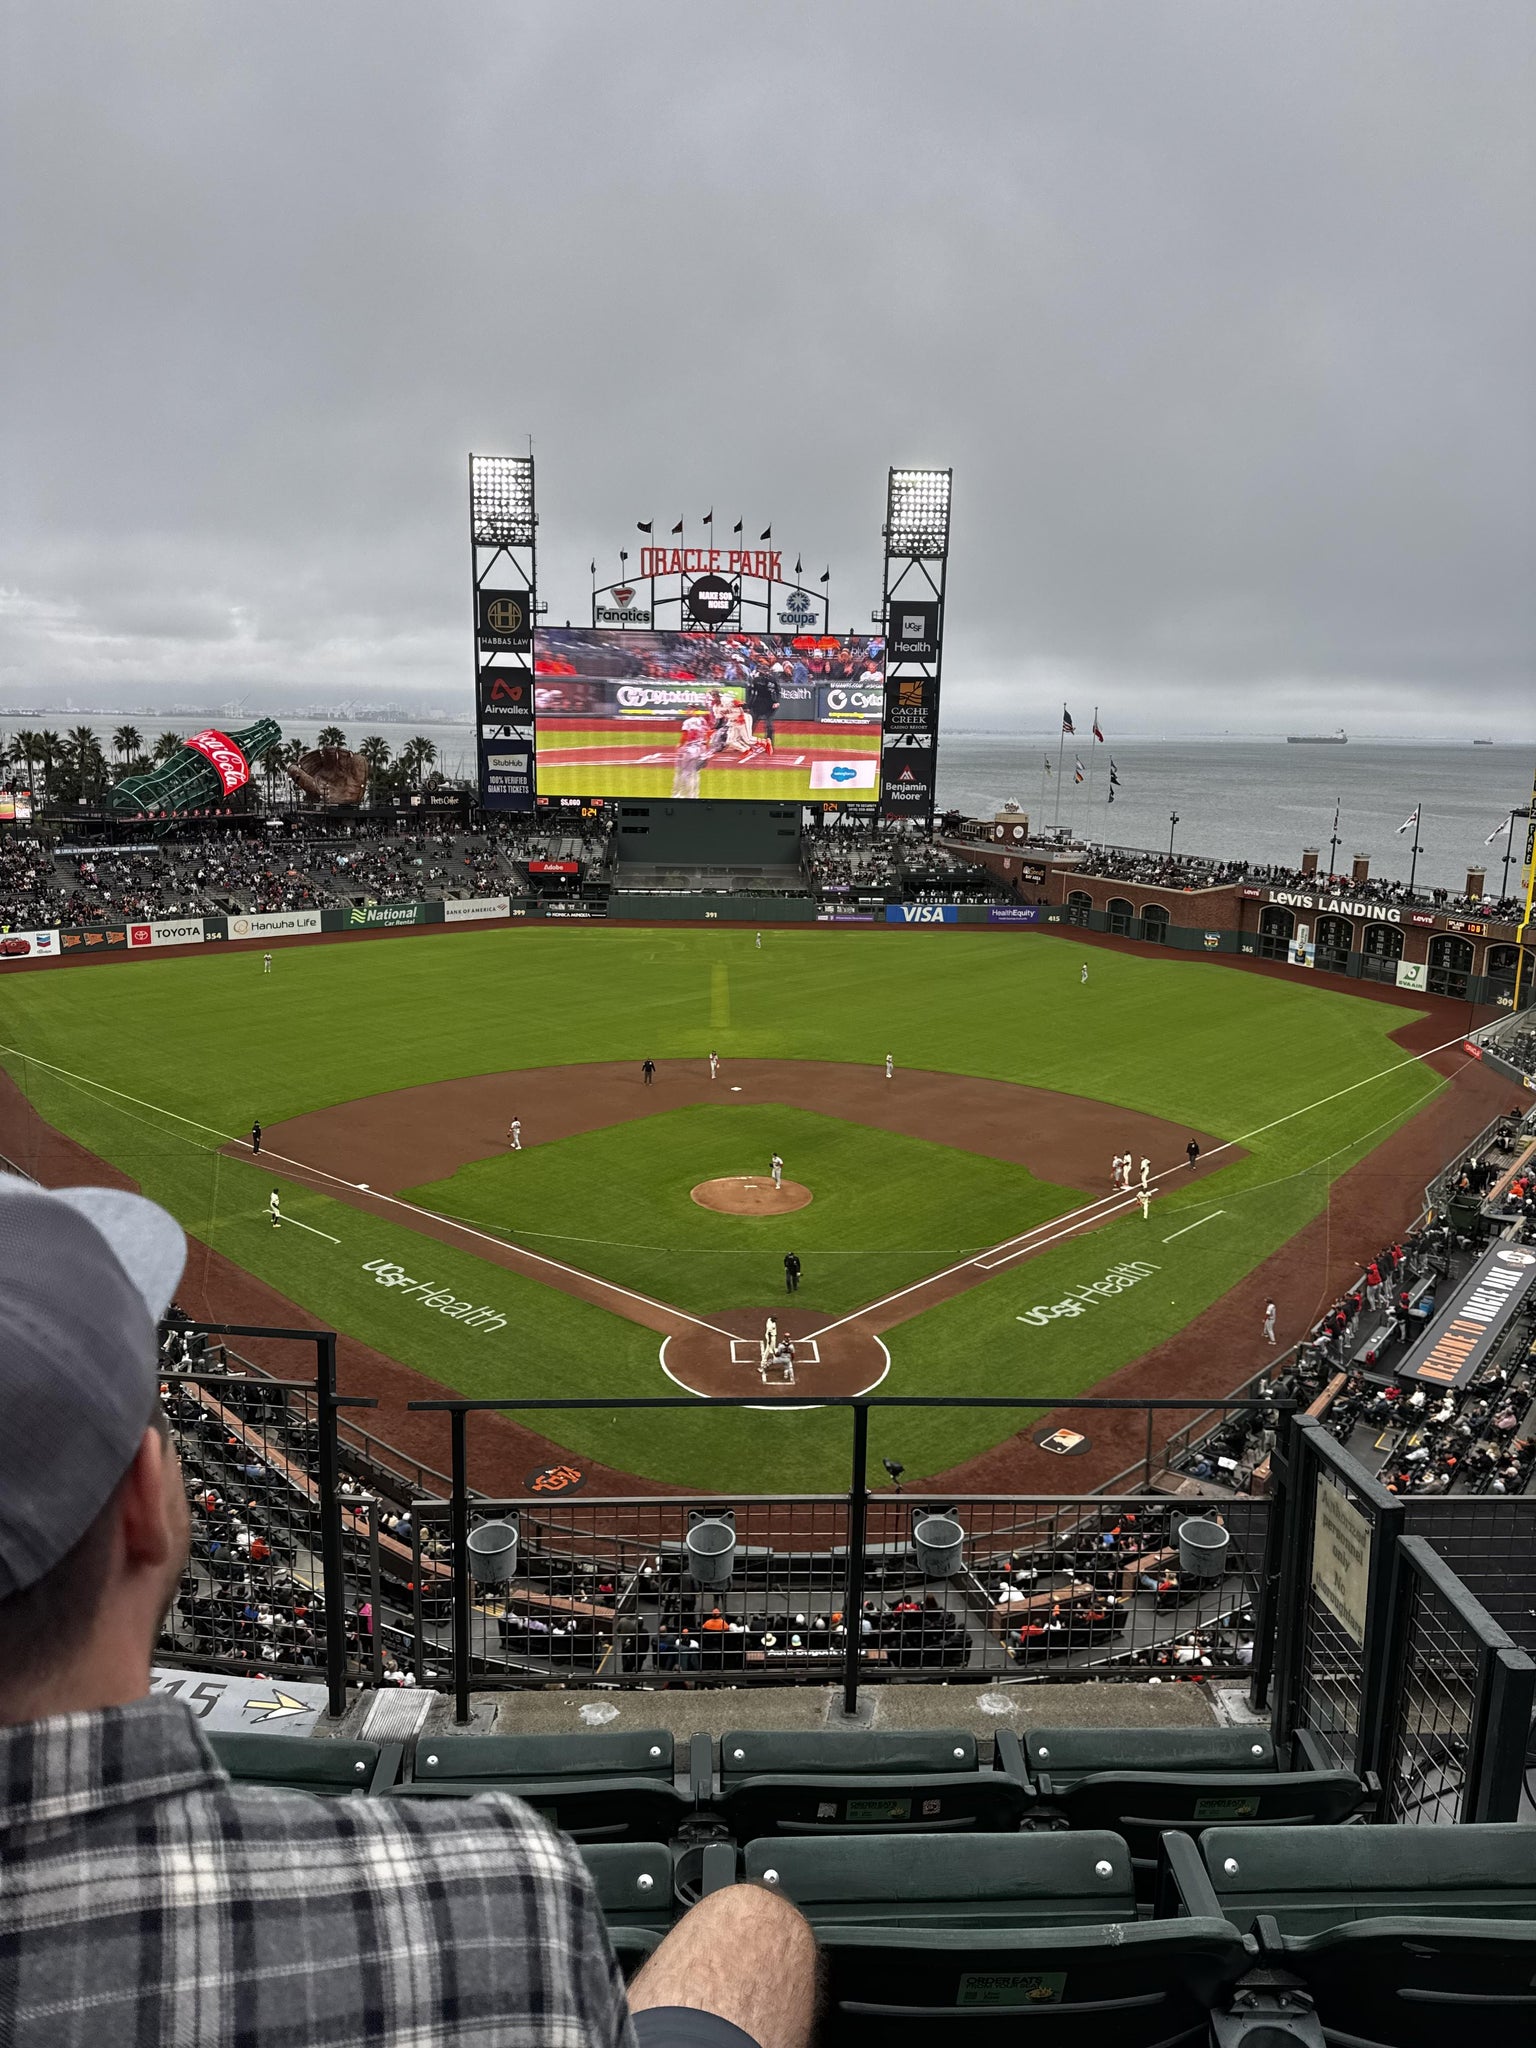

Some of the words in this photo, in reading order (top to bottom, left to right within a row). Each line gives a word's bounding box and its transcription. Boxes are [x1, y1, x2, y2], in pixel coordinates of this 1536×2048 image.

[640, 547, 721, 578] ORACLE
[728, 550, 783, 582] PARK
[596, 606, 650, 623] Fanatics
[781, 613, 816, 627] coupa
[481, 637, 511, 646] HABBAS
[512, 638, 529, 646] LAW
[894, 641, 931, 652] Health
[484, 704, 529, 715] Airwallex
[891, 707, 929, 716] CACHE
[891, 715, 927, 724] CREEK
[492, 759, 523, 767] StubHub
[489, 776, 503, 785] 100%
[504, 776, 528, 785] VERIFIED
[488, 784, 507, 794] GIANTS
[508, 785, 529, 794] TICKETS
[886, 781, 927, 794] Benjamin
[891, 791, 921, 801] Moore
[367, 906, 418, 922] National
[705, 911, 718, 919] 391
[900, 906, 944, 923] VISA
[992, 908, 1036, 918] HealthEquity
[1318, 898, 1400, 923] LANDING
[251, 920, 295, 931] Hanwha
[296, 918, 317, 928] Life
[395, 918, 416, 926] Rental
[155, 926, 201, 938] TOYOTA
[206, 932, 222, 940] 354
[1241, 945, 1253, 953] 365
[1496, 996, 1514, 1007] 309
[1480, 1266, 1524, 1292] PARK
[361, 1258, 417, 1288] UCSF
[400, 1281, 508, 1334] Health
[1016, 1298, 1086, 1327] UCSF
[1063, 1260, 1162, 1305] Health
[1458, 1287, 1510, 1323] ORACLE
[1449, 1319, 1488, 1336] TO
[1416, 1332, 1479, 1381] WELCOME
[1321, 1489, 1367, 1549] Authorized
[1321, 1512, 1364, 1567] personnel
[1331, 1544, 1352, 1574] only
[1332, 1569, 1347, 1597] No
[966, 1976, 1011, 1985] ORDER
[1012, 1975, 1043, 1985] EATS
